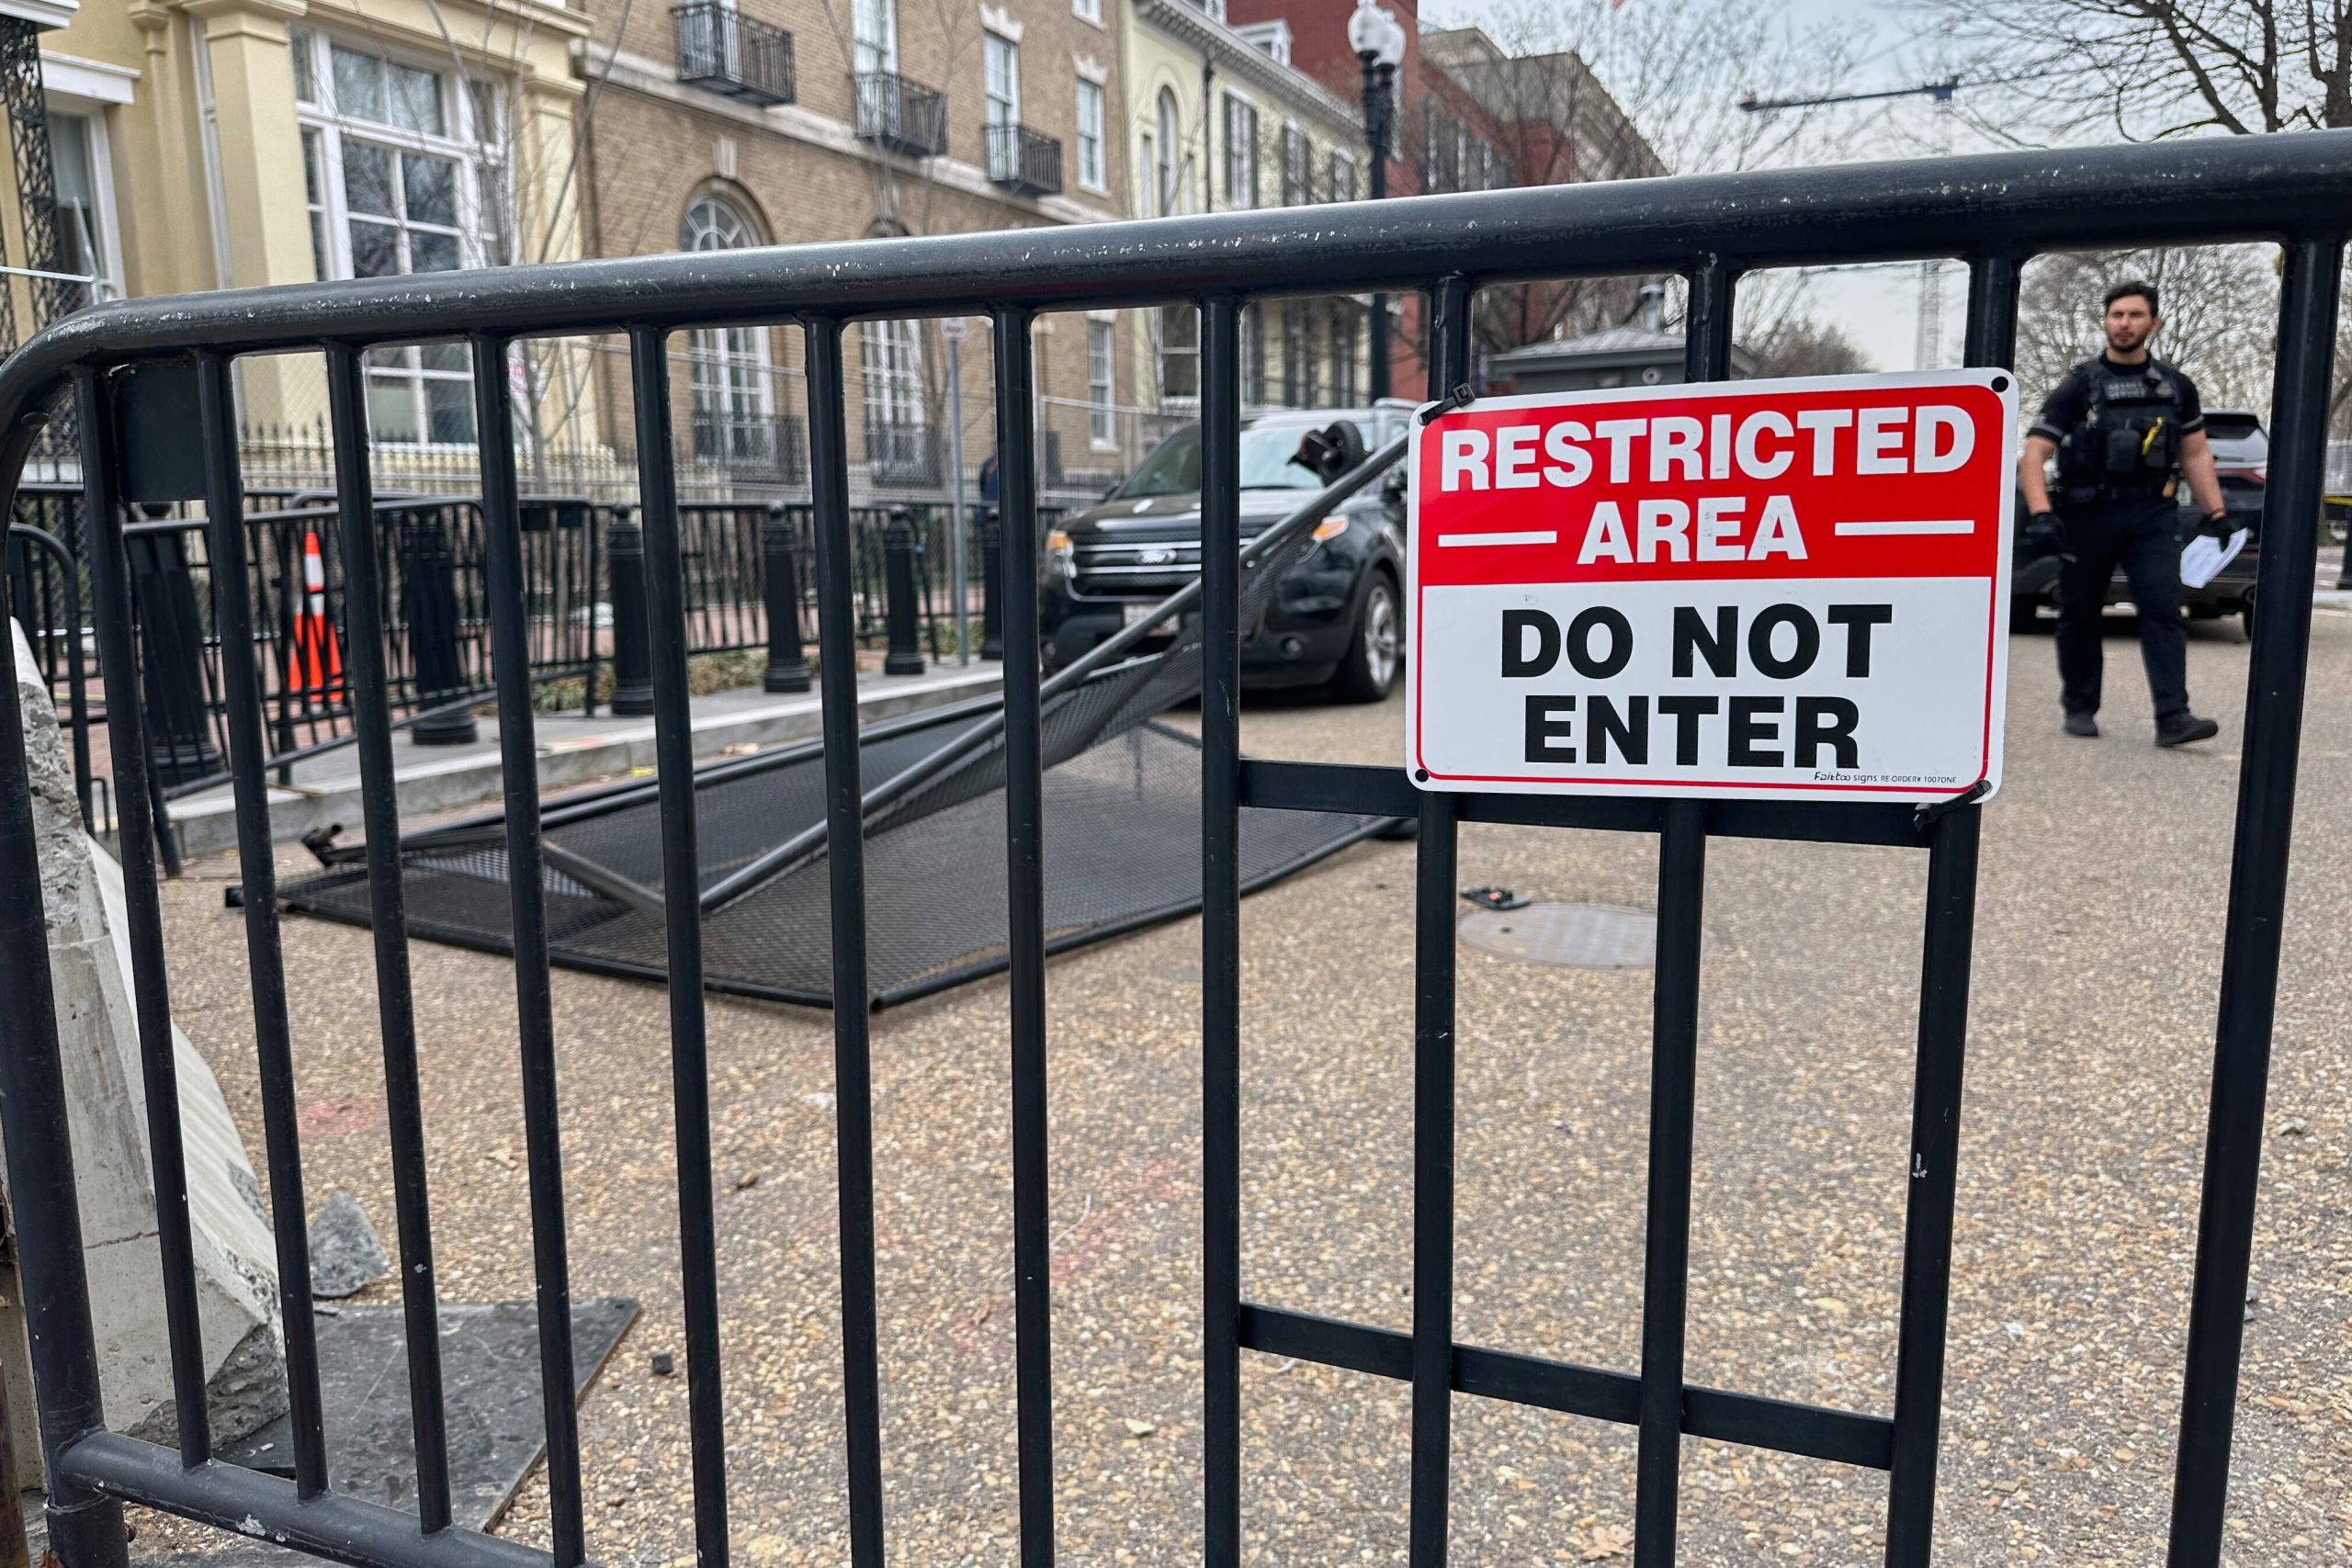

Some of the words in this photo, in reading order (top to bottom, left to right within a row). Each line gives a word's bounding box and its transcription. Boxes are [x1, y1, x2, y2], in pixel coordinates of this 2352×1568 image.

[1441, 404, 1976, 491] RESTRICTED
[1577, 494, 1808, 565] AREA
[1500, 605, 1634, 679] DO
[1671, 603, 1893, 678] NOT
[1524, 694, 1860, 769] ENTER
[1853, 773, 1878, 784] signs
